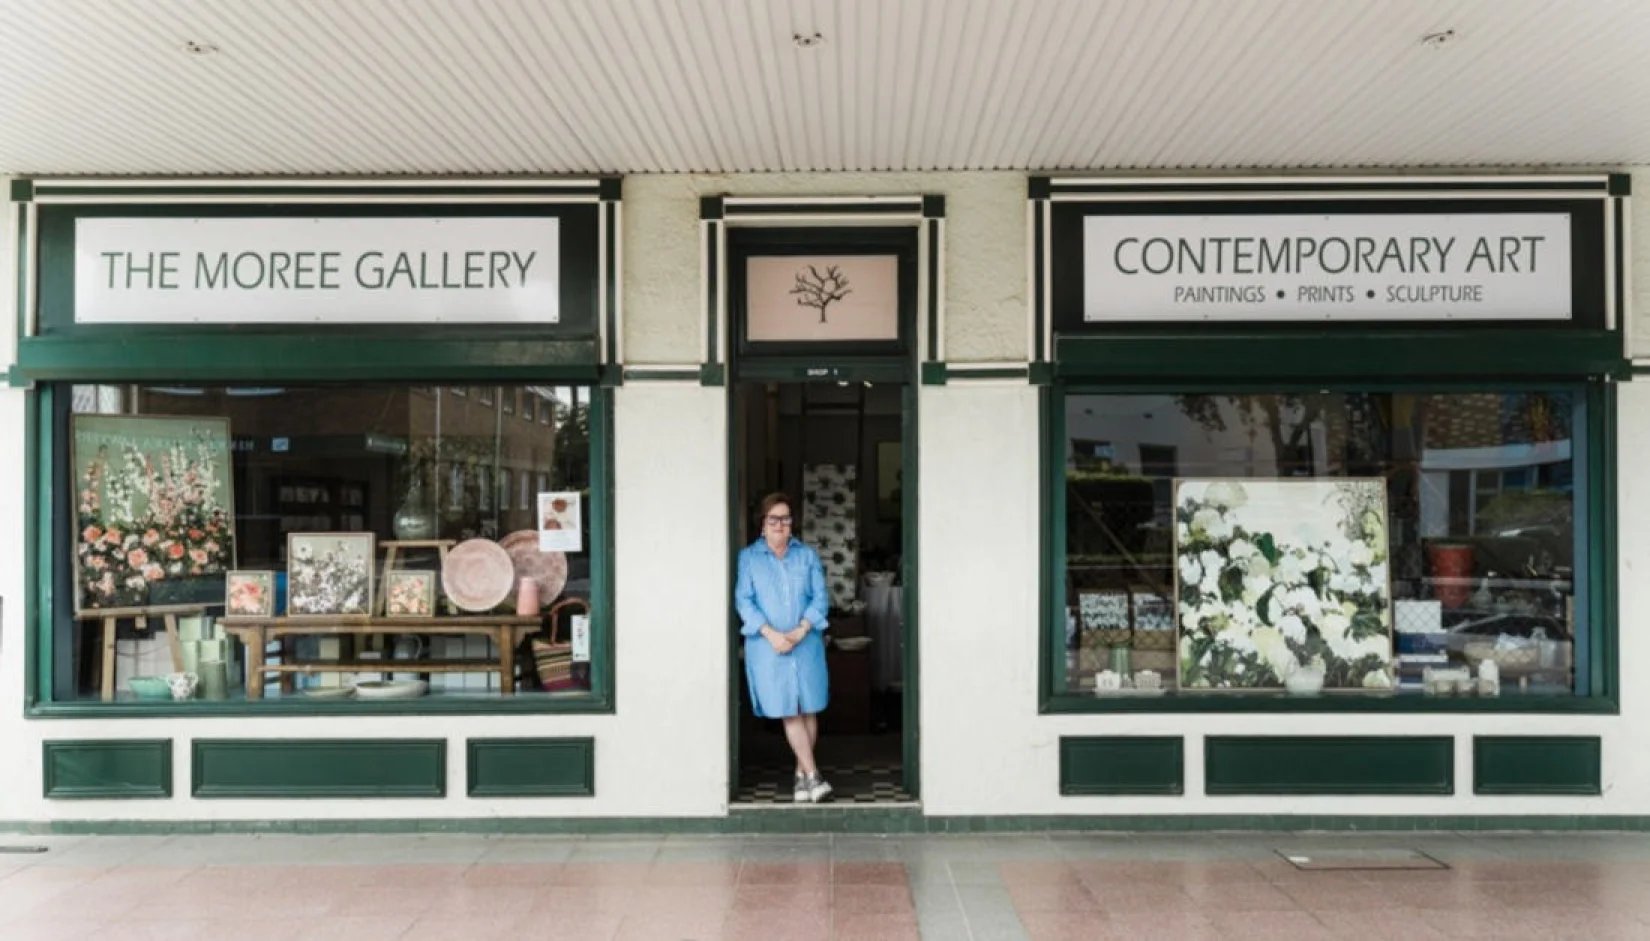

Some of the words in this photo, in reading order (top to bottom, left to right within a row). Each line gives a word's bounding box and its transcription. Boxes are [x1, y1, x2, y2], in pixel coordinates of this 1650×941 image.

[101, 251, 180, 289] THE
[195, 251, 341, 289] MOREE
[355, 251, 537, 289] GALLERY
[1113, 236, 1456, 275] CONTEMPORARY
[1465, 236, 1546, 273] ART
[1174, 285, 1266, 303] PAINTINGS
[1297, 284, 1355, 303] PRINTS
[1386, 284, 1483, 303] SCULPTURE
